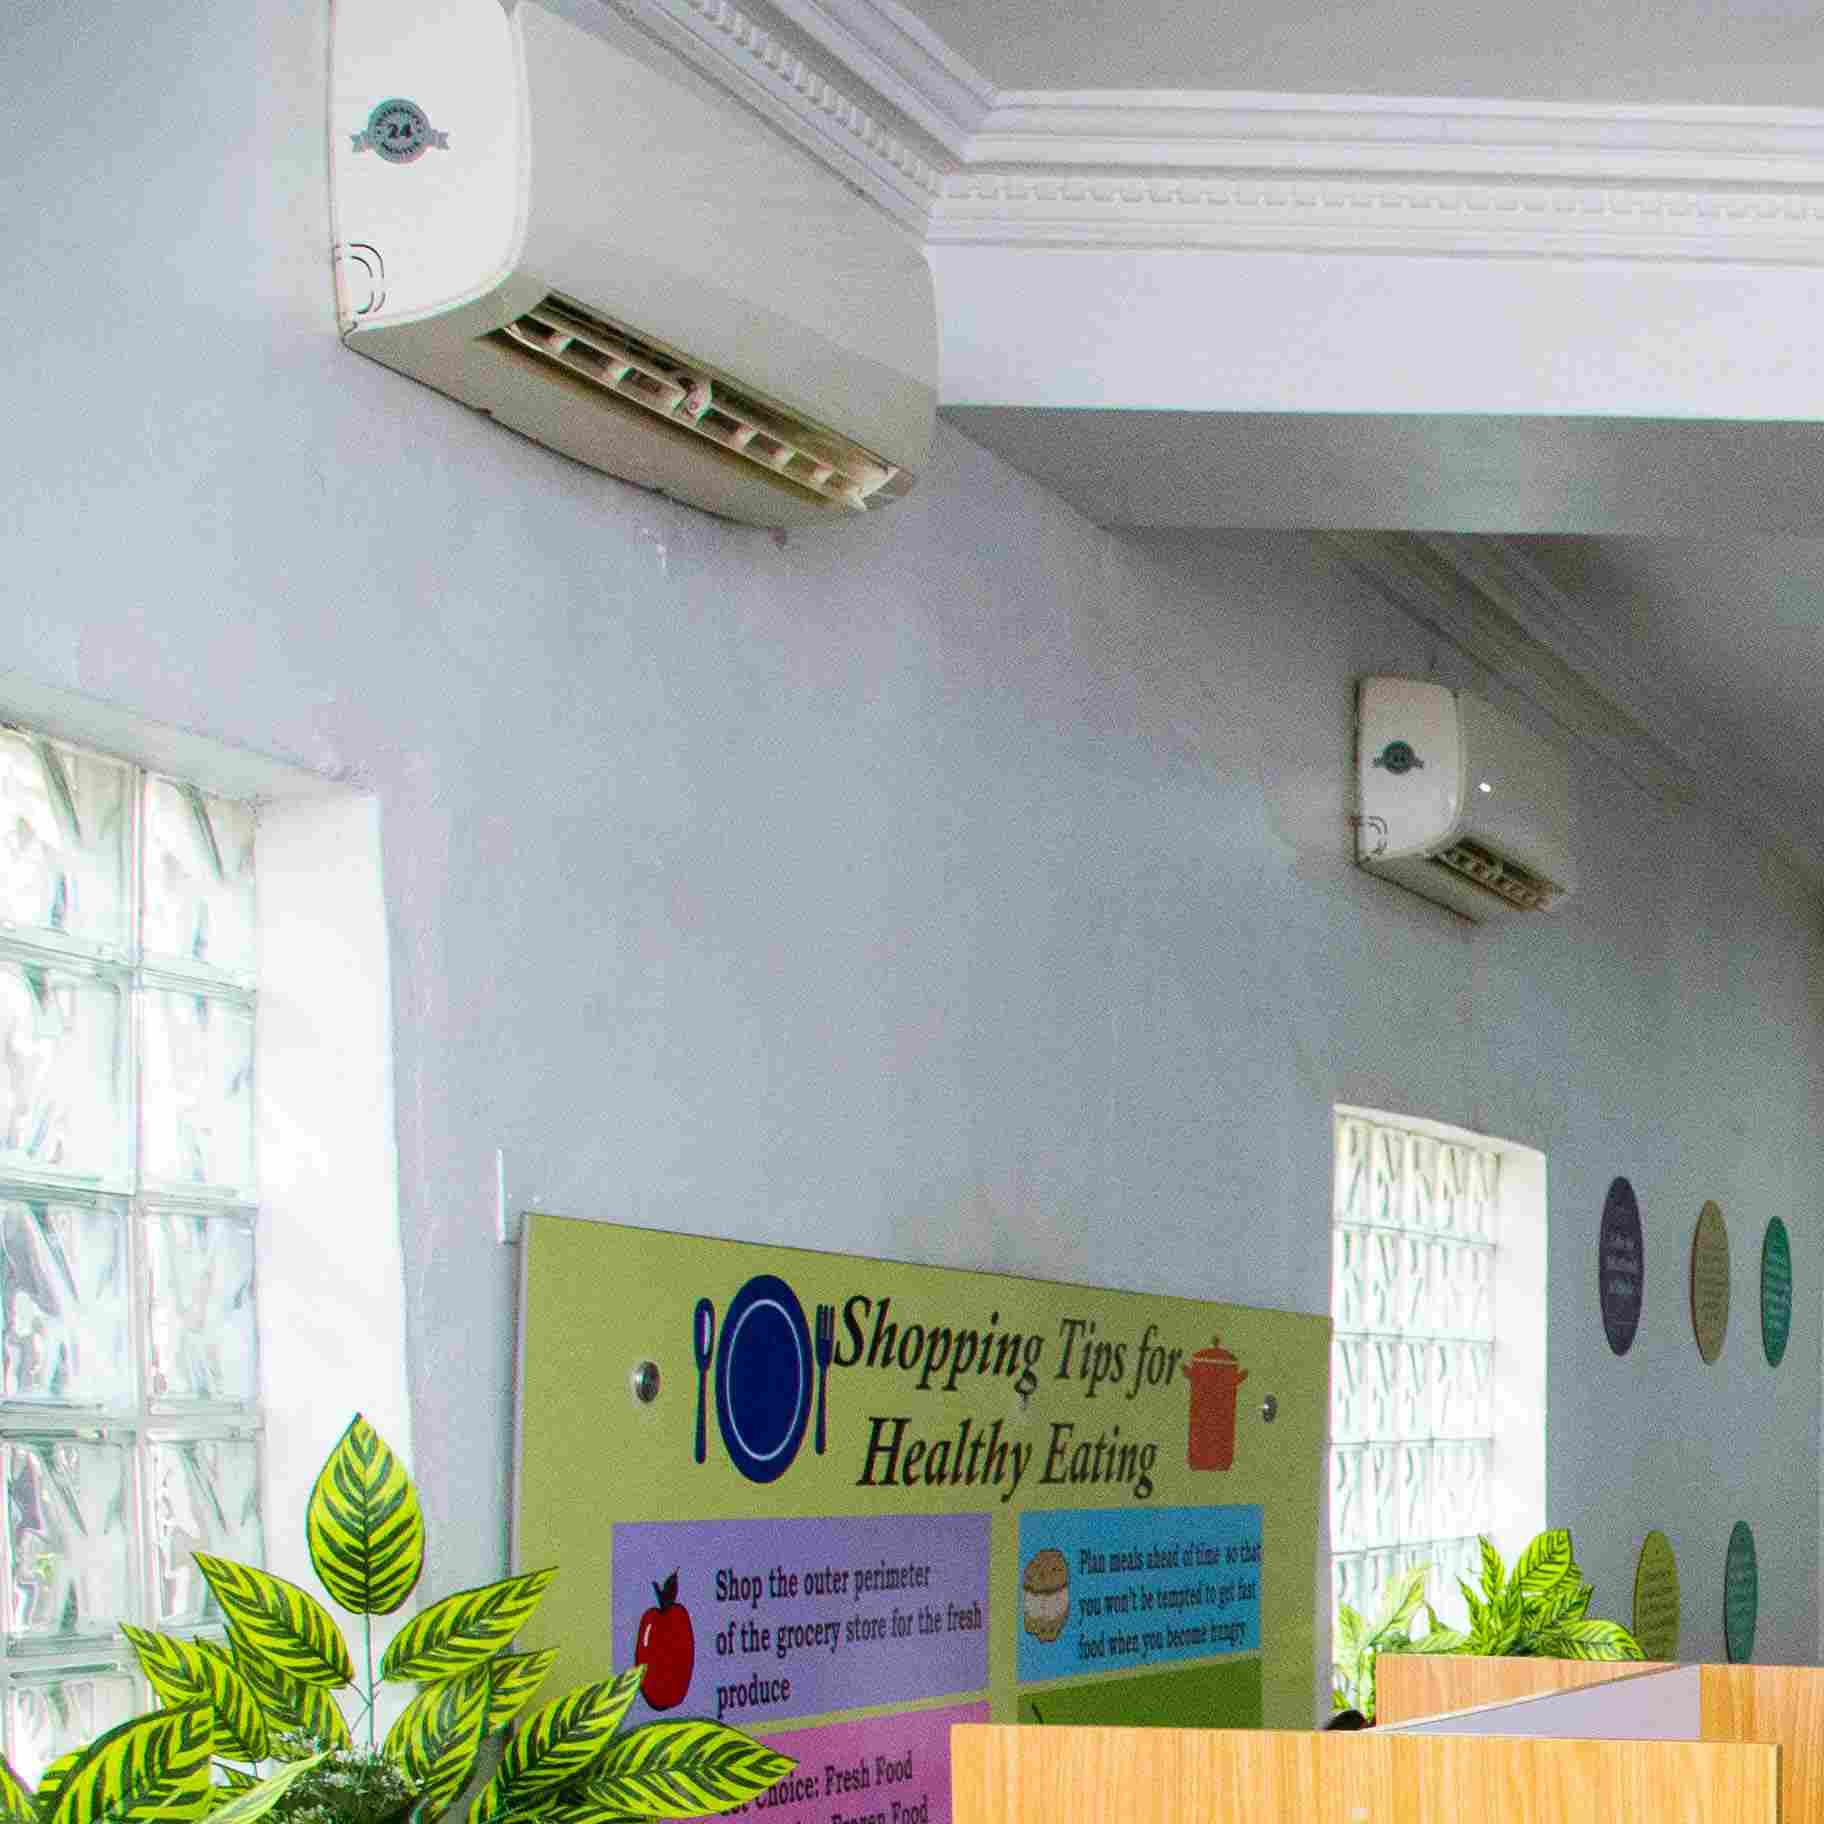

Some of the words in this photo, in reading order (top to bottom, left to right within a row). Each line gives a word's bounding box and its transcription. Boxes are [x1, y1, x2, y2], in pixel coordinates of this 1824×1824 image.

[833, 1295, 1045, 1396] Shopping
[1053, 1317, 1128, 1398] Tips
[1125, 1324, 1185, 1400] for
[856, 1417, 1033, 1502] Healthy
[1039, 1422, 1159, 1499] Eating
[1080, 1548, 1105, 1575] Plan
[1109, 1546, 1144, 1573] meals
[1147, 1542, 1179, 1568] ahead
[715, 1568, 763, 1608] Shop
[769, 1565, 799, 1599] the
[804, 1569, 850, 1596] outer
[853, 1560, 931, 1601] perimeter
[716, 1620, 737, 1656] of
[740, 1621, 770, 1652] the
[776, 1620, 841, 1659] grocery
[845, 1614, 887, 1643] store
[889, 1607, 914, 1638] for
[918, 1604, 942, 1634] the
[947, 1601, 982, 1632] fresh
[716, 1673, 792, 1720] produce
[824, 1760, 871, 1797] Fresh
[875, 1750, 913, 1786] Food
